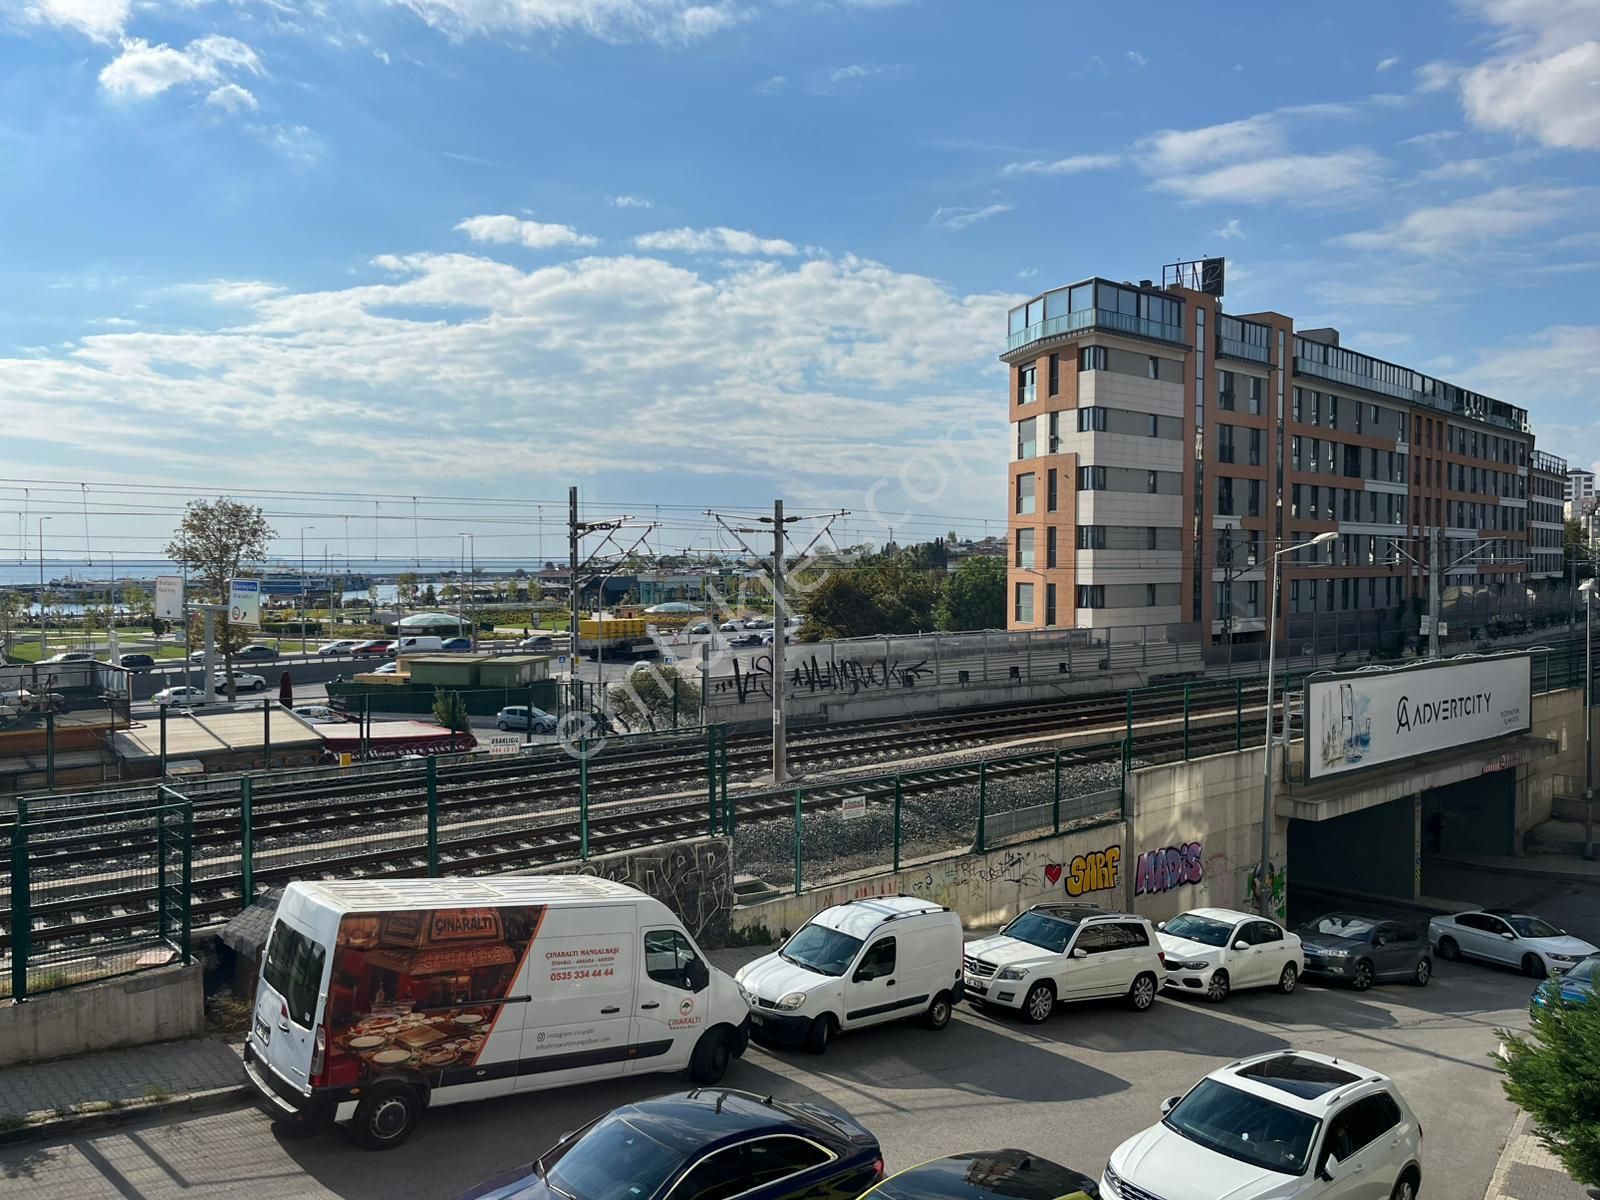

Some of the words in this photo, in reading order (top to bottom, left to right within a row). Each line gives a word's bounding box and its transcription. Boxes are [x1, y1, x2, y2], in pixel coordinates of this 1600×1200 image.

[1412, 693, 1491, 726] ADVERTCITY
[435, 917, 493, 934] ÇINARALTI
[545, 950, 579, 960] ÇINARALTI
[580, 947, 620, 956] MANGALBAŞI
[550, 972, 572, 981] 0535
[574, 970, 590, 979] 334
[592, 969, 602, 977] 44
[604, 968, 614, 976] 44
